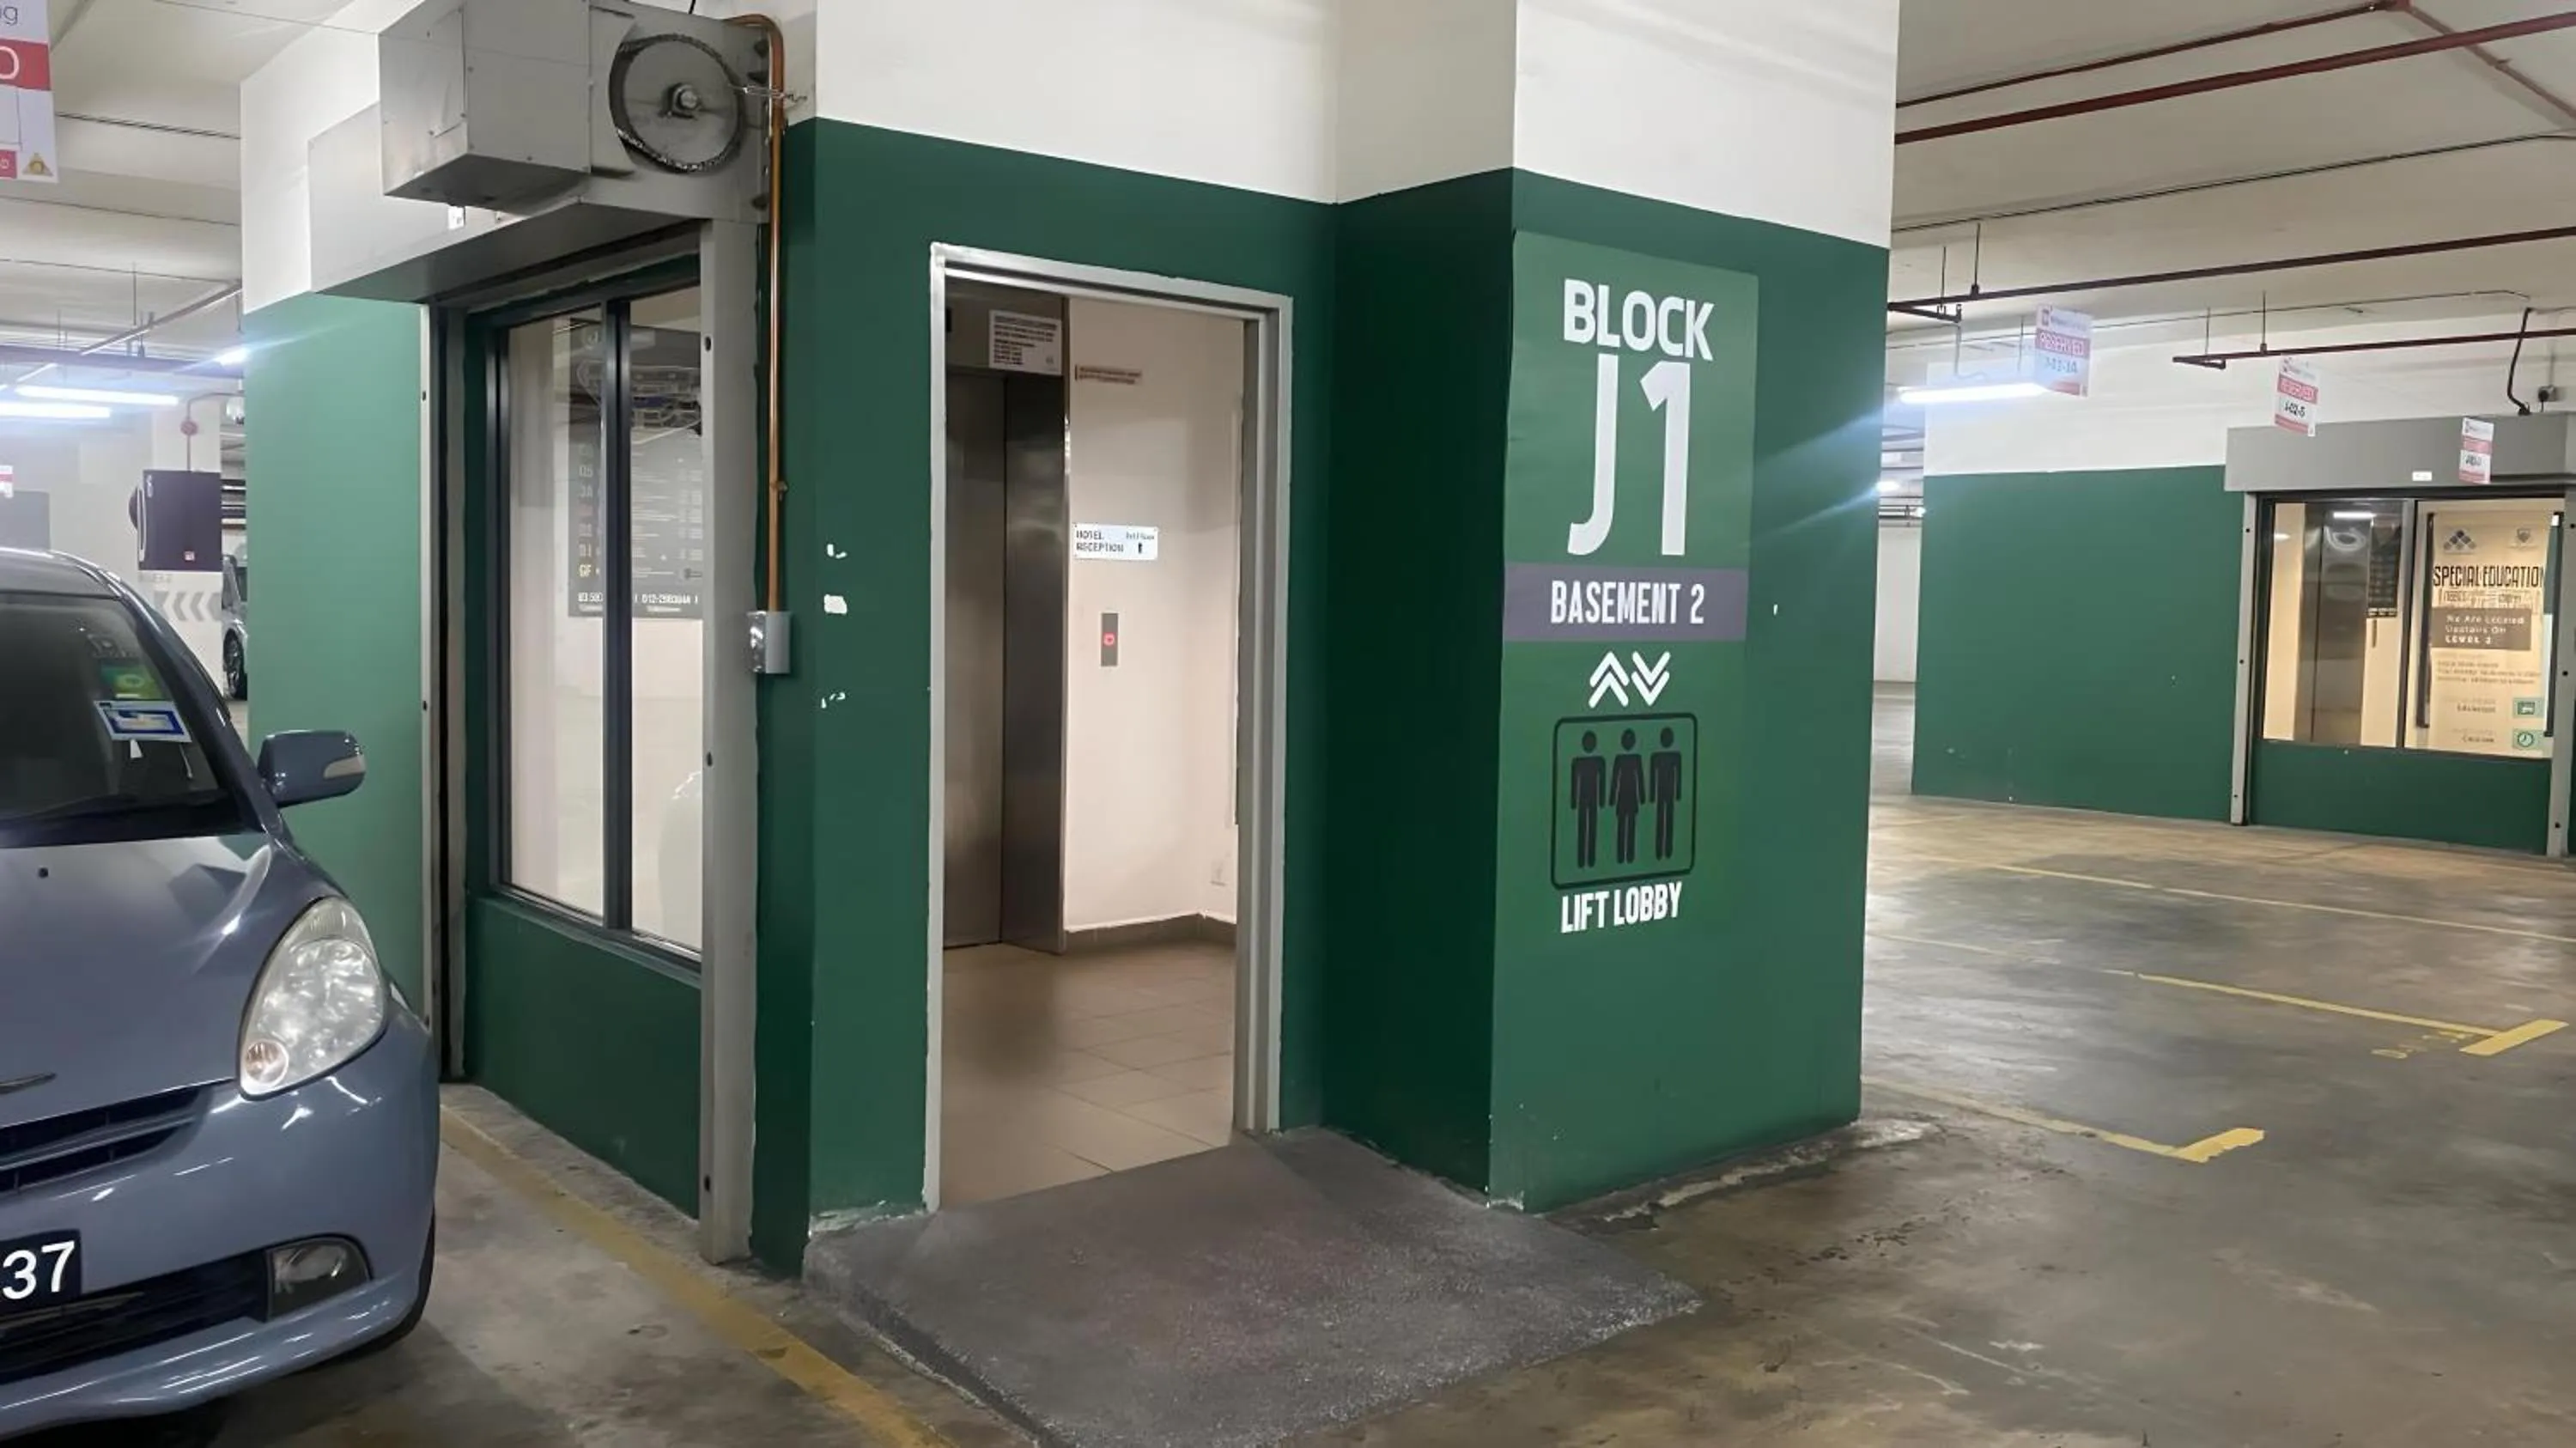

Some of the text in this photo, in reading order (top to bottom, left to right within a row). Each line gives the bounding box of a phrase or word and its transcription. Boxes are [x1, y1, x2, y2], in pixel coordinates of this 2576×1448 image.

[1564, 278, 1715, 361] BLOCK
[1567, 353, 1691, 556] J1
[1076, 530, 1104, 539] HOTEL
[1550, 579, 1705, 625] BASEMENT 2
[2433, 564, 2481, 587] SPECIAL
[1561, 881, 1683, 934] LIFT LOBBY
[3, 1240, 75, 1299] 37
